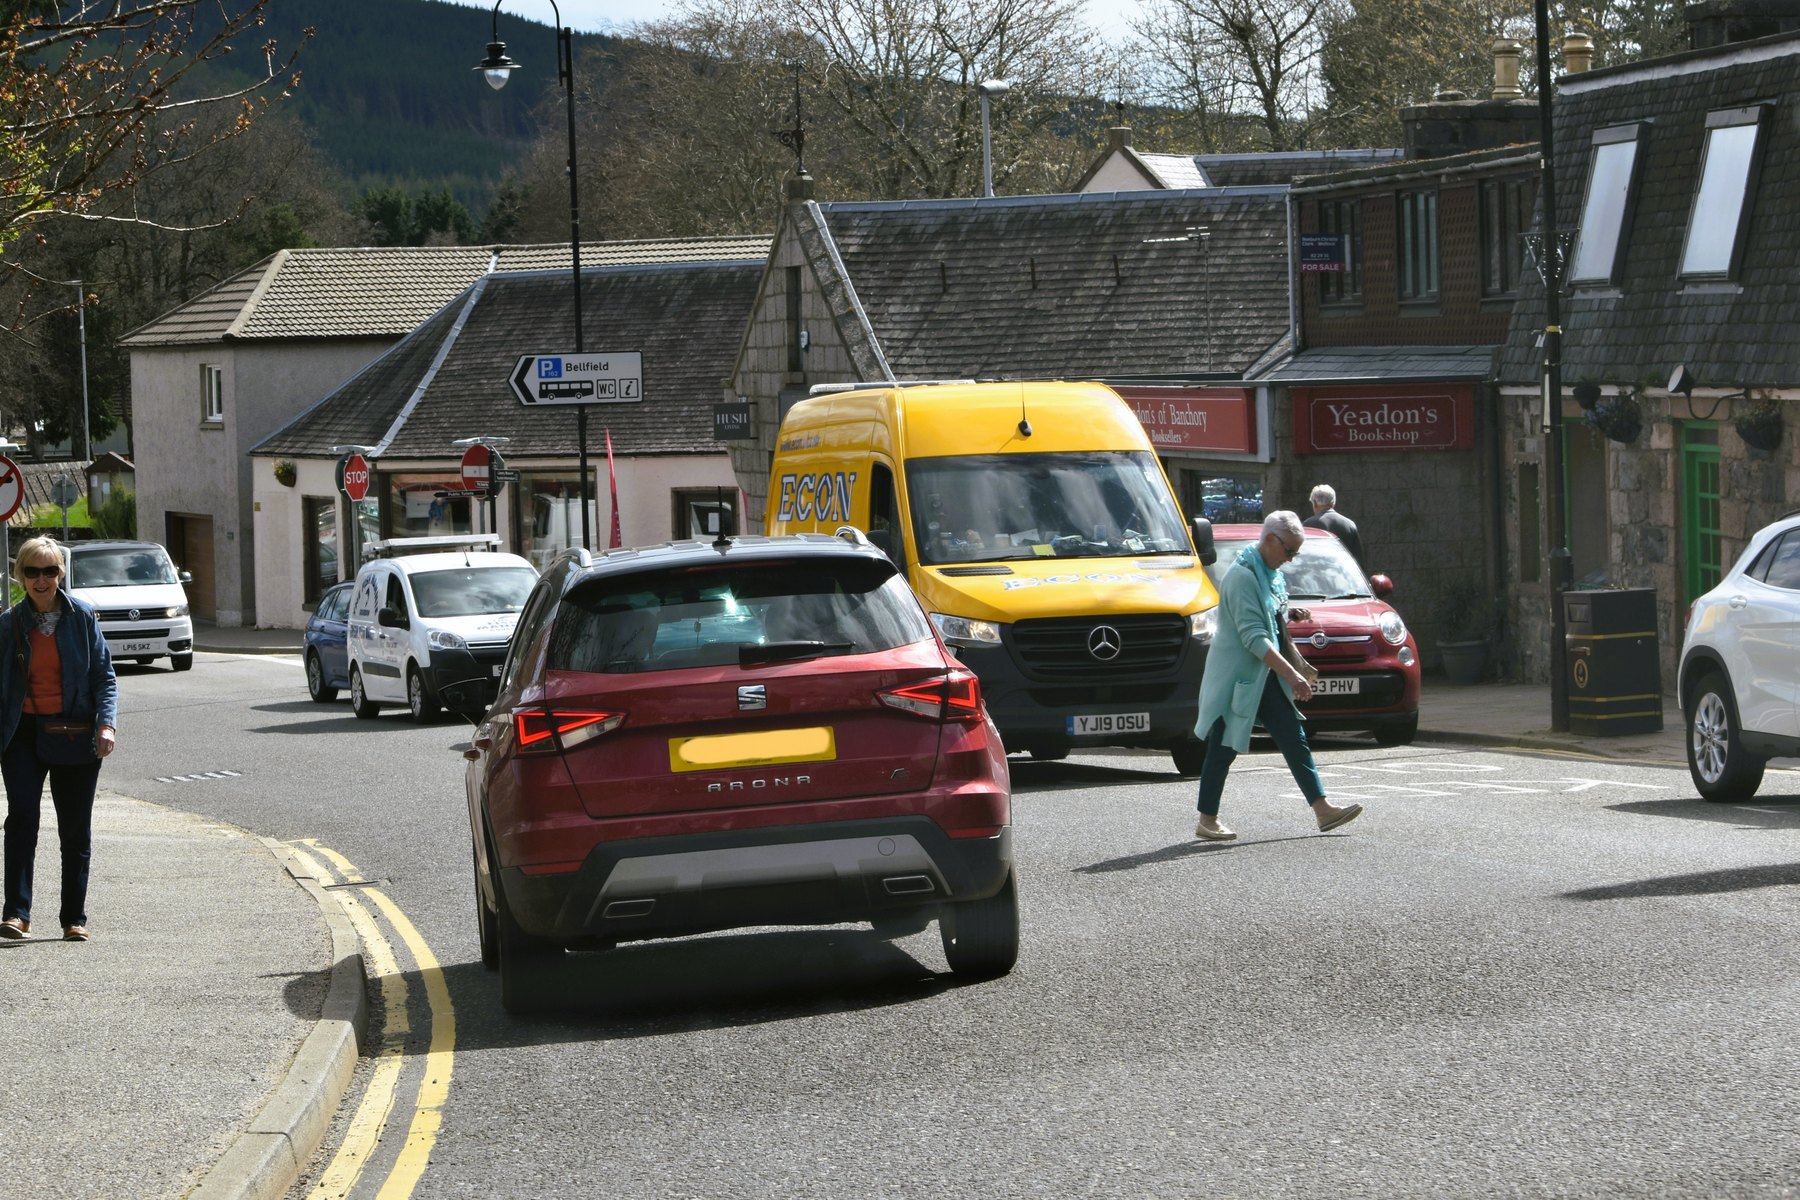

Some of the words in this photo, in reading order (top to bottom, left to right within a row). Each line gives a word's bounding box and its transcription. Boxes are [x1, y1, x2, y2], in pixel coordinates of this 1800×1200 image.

[1302, 263, 1318, 271] FOR
[1319, 263, 1340, 271] SALE
[541, 360, 553, 377] P
[565, 362, 609, 372] Bellfield
[599, 383, 615, 395] WC
[716, 412, 748, 425] HUSH
[1131, 402, 1156, 425] don's
[1158, 402, 1167, 425] of
[1169, 403, 1207, 433] Banchory
[1327, 403, 1438, 426] Yeadon's
[1151, 429, 1182, 444] Booksellers
[1348, 427, 1419, 444] Bookshop
[345, 470, 368, 485] STOP
[777, 471, 857, 522] ECON
[1002, 573, 1163, 590] ECON
[1329, 679, 1354, 693] PHV
[1079, 716, 1113, 732] YJ19
[1116, 715, 1145, 730] OSU
[707, 774, 811, 793] ARONA
